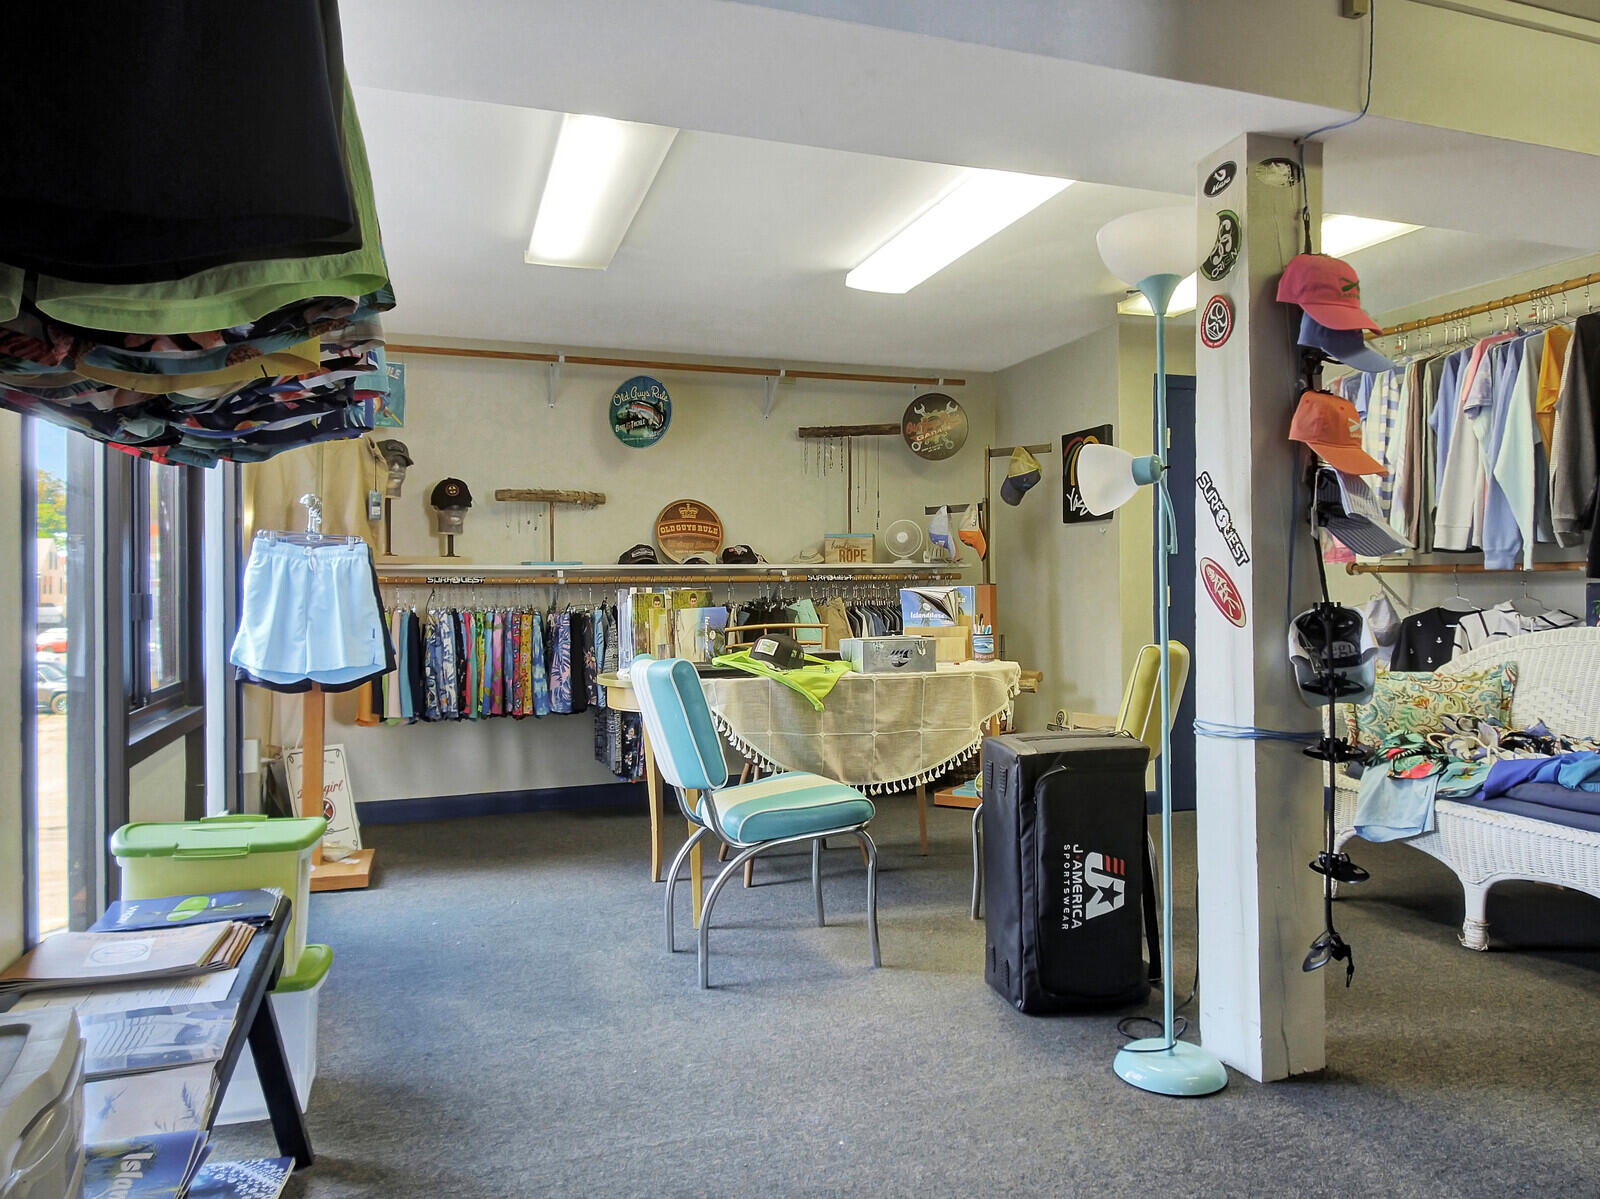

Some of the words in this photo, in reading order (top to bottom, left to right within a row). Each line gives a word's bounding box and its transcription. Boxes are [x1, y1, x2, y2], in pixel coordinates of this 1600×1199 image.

[613, 391, 630, 406] Old
[630, 386, 650, 401] Guys
[651, 385, 669, 402] Rule
[660, 526, 676, 534] OLD
[676, 524, 697, 532] GUYS
[698, 525, 719, 535] RULE
[1198, 472, 1249, 566] SURFQUEST
[1061, 844, 1071, 930] SPORTSWEAR
